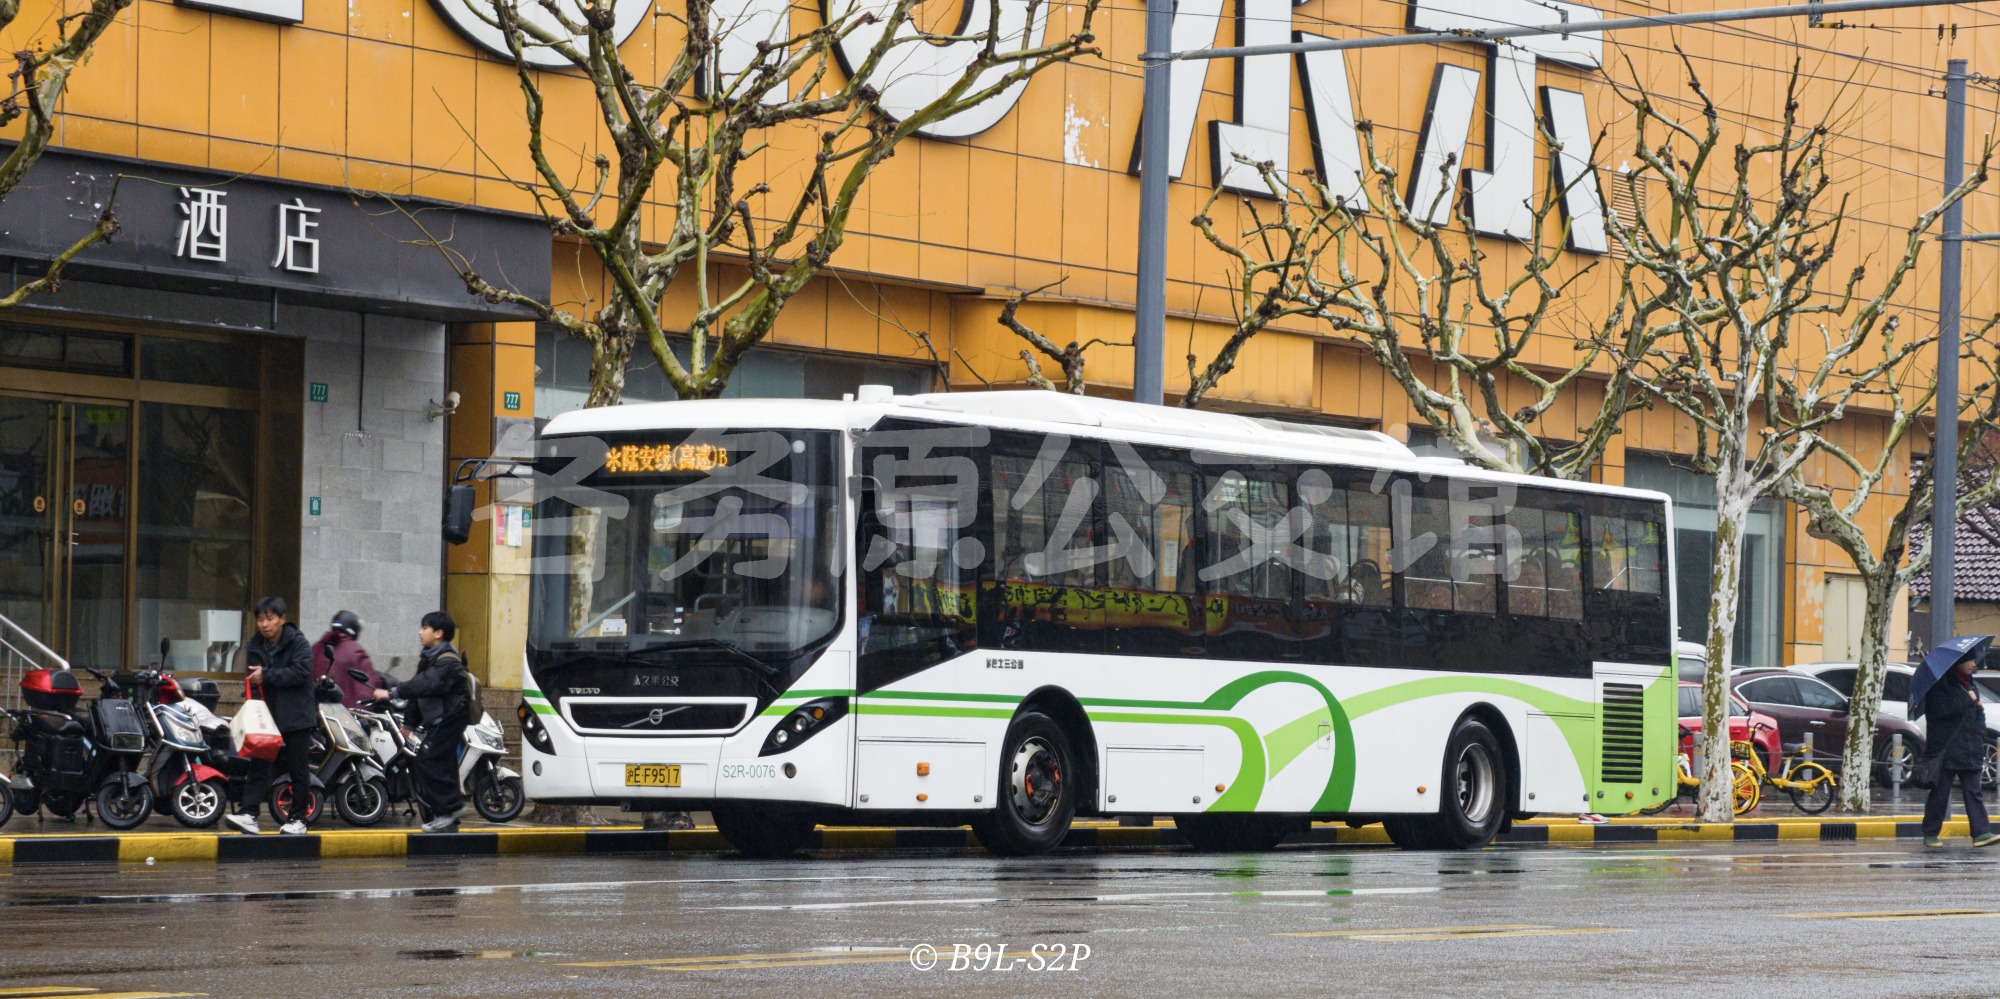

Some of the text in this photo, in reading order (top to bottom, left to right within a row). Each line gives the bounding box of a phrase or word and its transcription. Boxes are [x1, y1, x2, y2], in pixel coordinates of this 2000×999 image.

[174, 186, 322, 274] 酒店
[312, 384, 326, 395] 777
[506, 393, 519, 405] 777
[568, 687, 601, 695] VOLVO
[722, 764, 776, 779] S2R-0076
